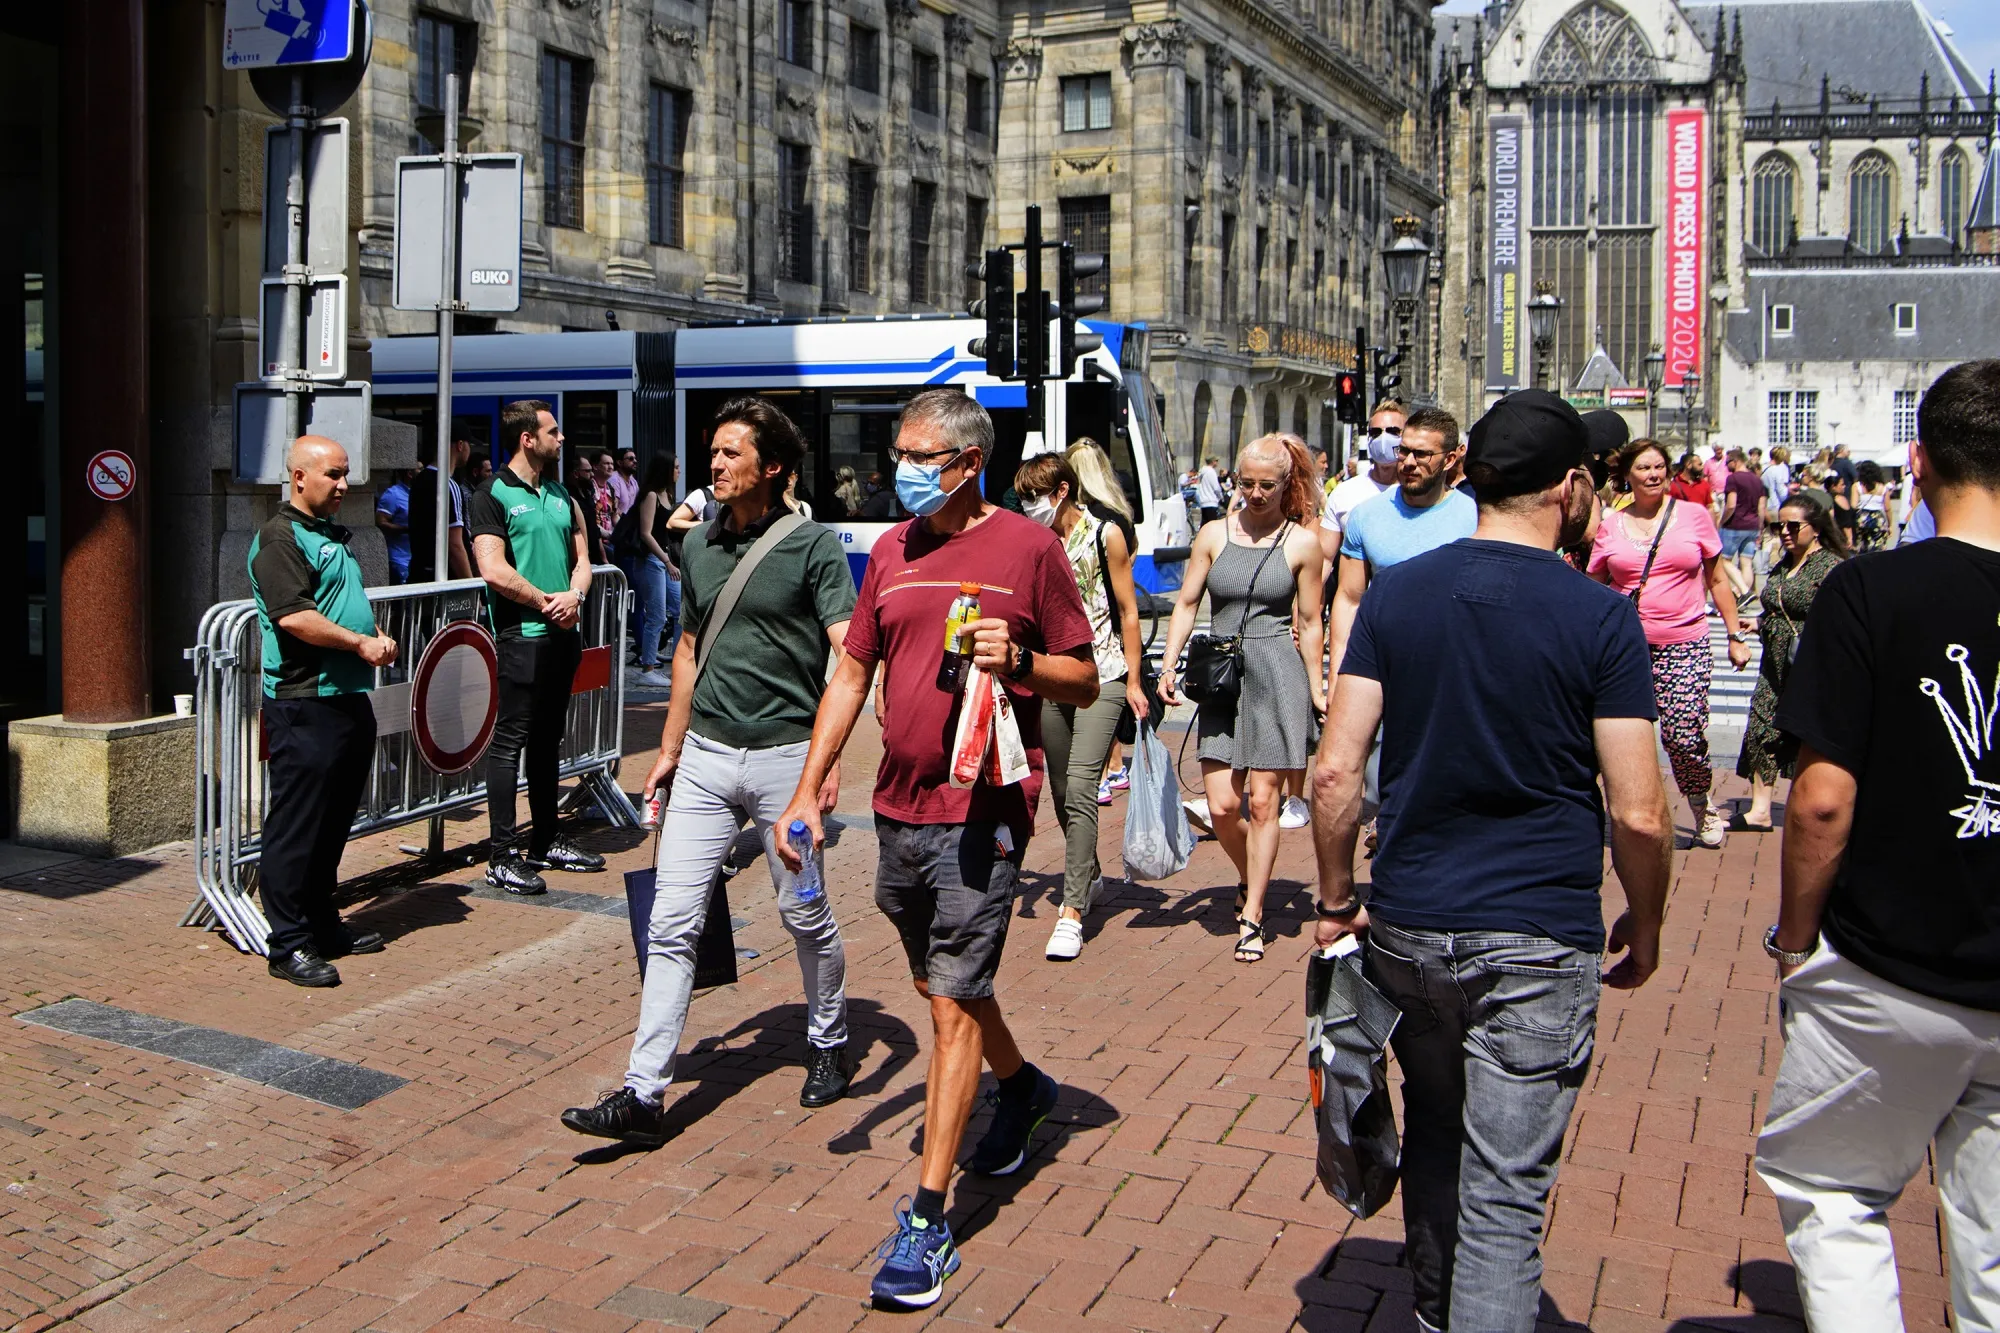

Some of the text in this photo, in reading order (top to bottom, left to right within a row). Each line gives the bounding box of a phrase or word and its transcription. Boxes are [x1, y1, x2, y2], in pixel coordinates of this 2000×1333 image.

[1494, 128, 1517, 266] WORLD PREMIERE
[1672, 121, 1697, 375] WORLD PRESS PHOTO 2020
[1502, 273, 1516, 376] ONLINE TICKETS ONLY
